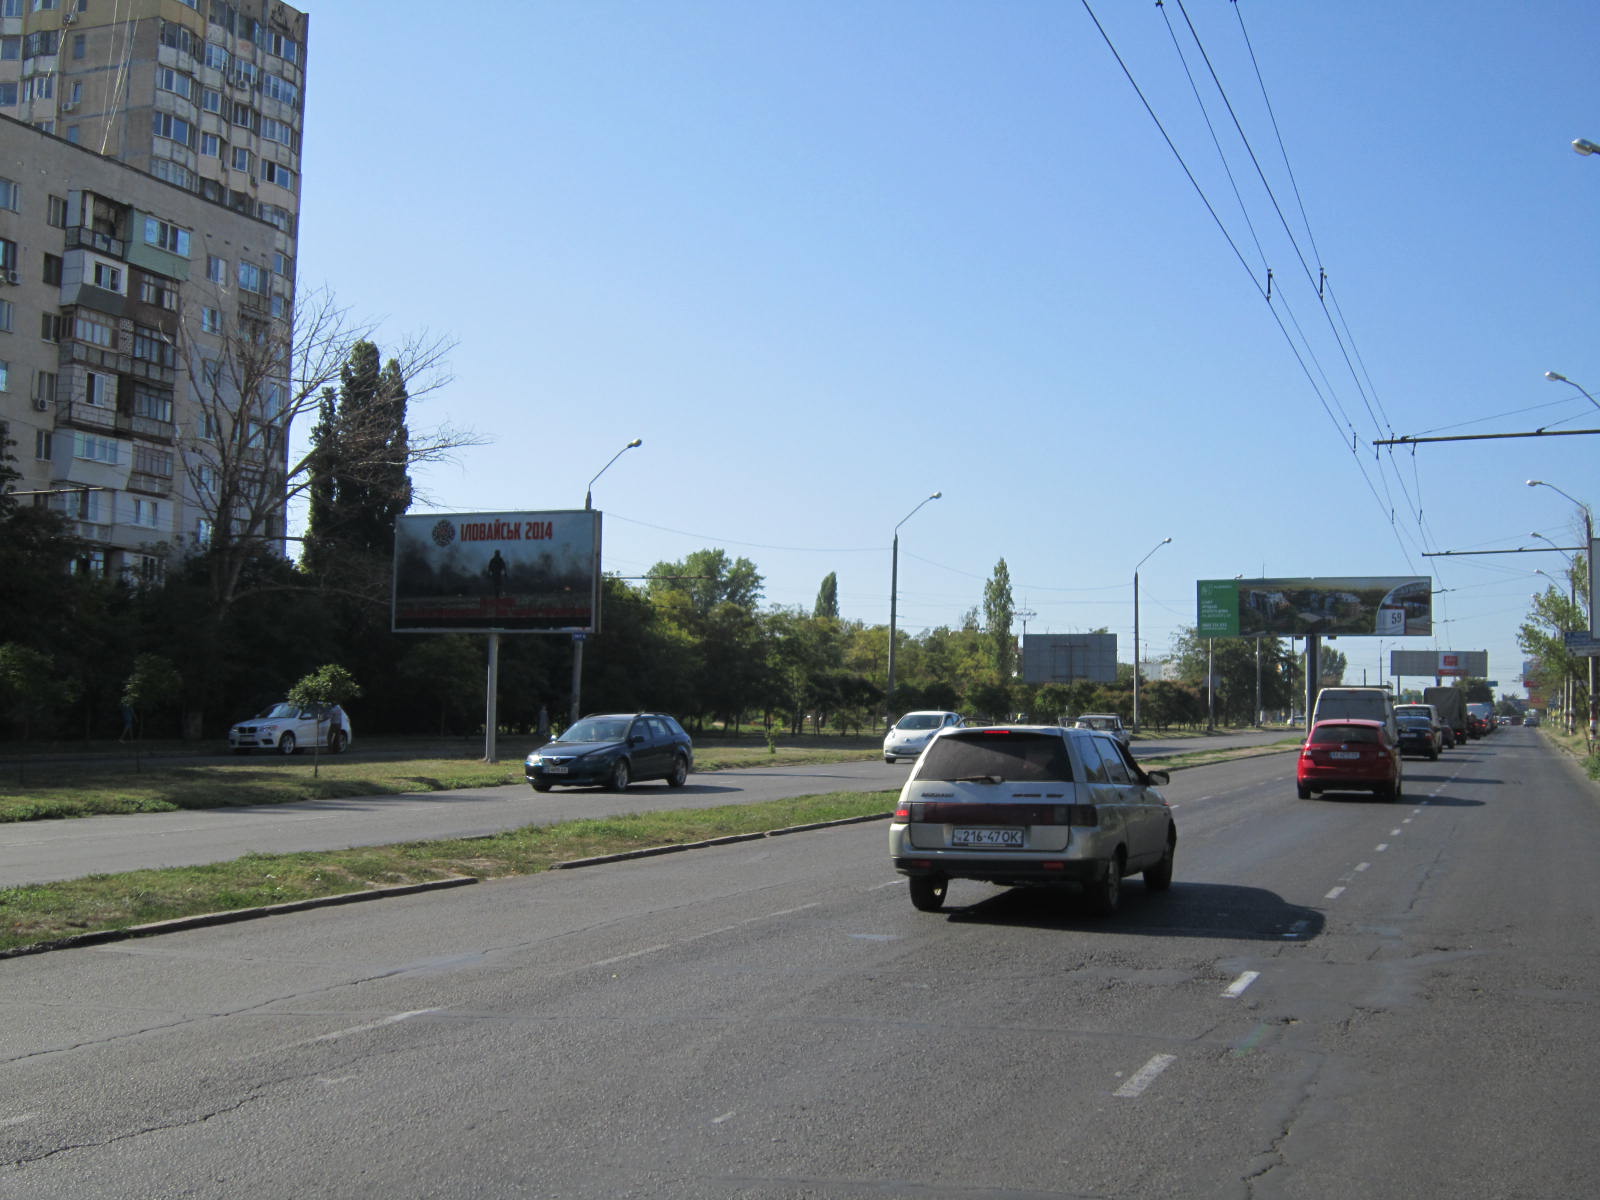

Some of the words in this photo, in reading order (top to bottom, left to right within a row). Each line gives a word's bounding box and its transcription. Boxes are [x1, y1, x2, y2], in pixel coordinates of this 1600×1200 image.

[460, 519, 521, 542] ІЛОВАЙСЬК
[525, 521, 553, 540] 2014
[1391, 612, 1402, 624] 59
